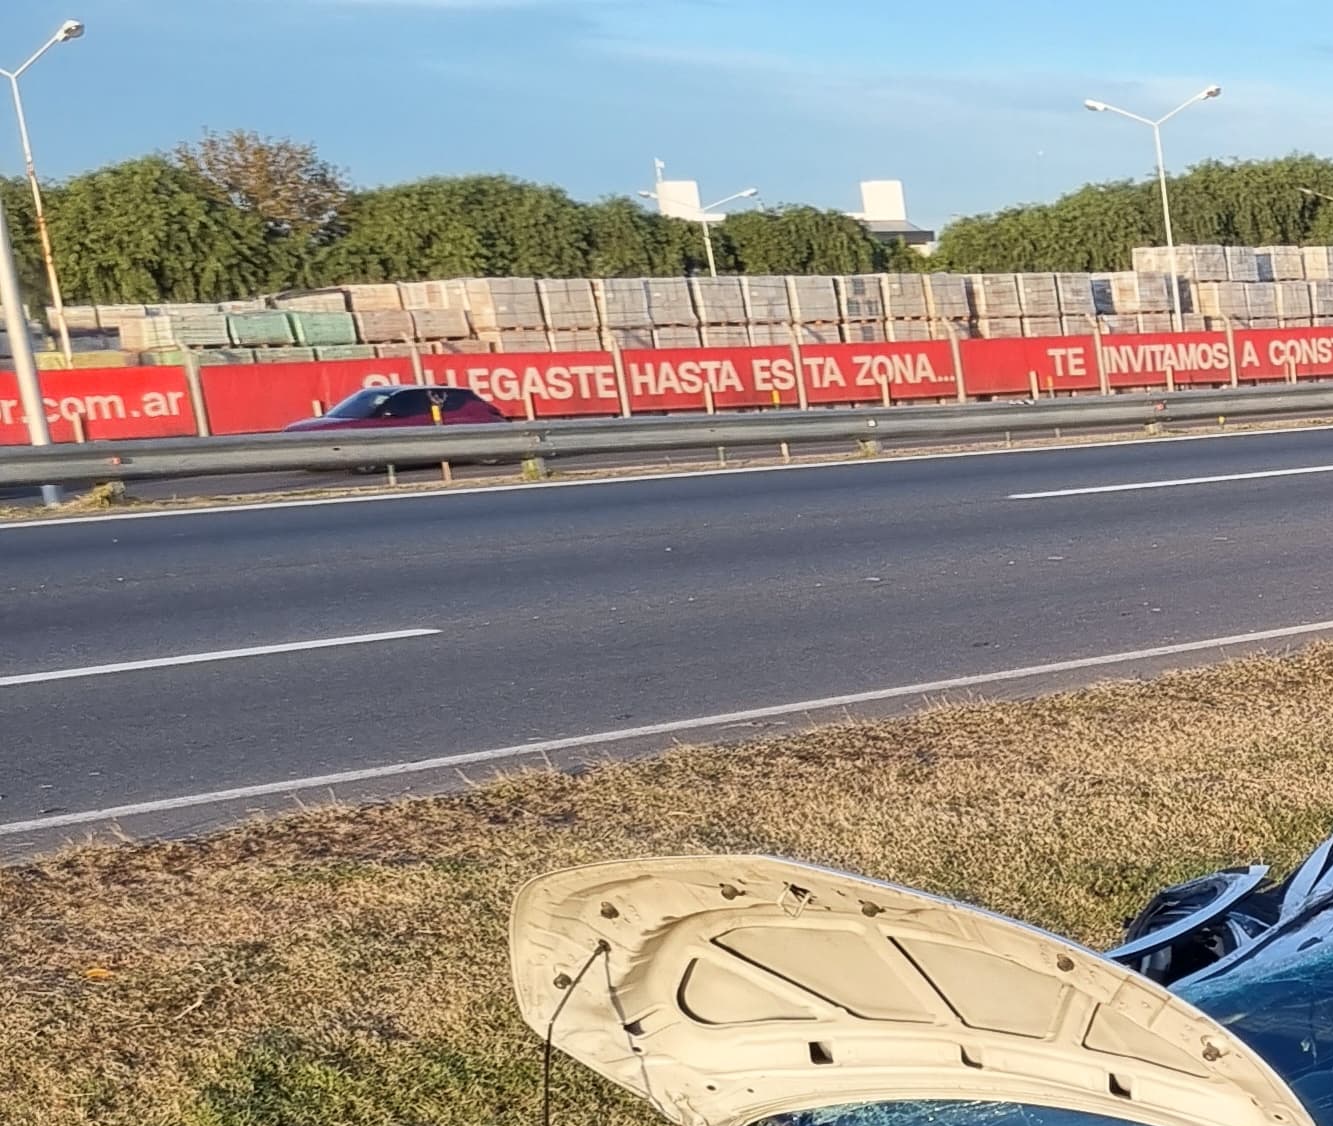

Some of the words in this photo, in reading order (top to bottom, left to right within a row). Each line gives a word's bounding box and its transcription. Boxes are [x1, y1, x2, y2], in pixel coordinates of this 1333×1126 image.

[630, 360, 744, 395] HASTA
[852, 352, 956, 387] ZONA...
[1047, 347, 1087, 377] TE
[1102, 341, 1229, 374] INVITAMOS
[1241, 340, 1261, 368] A
